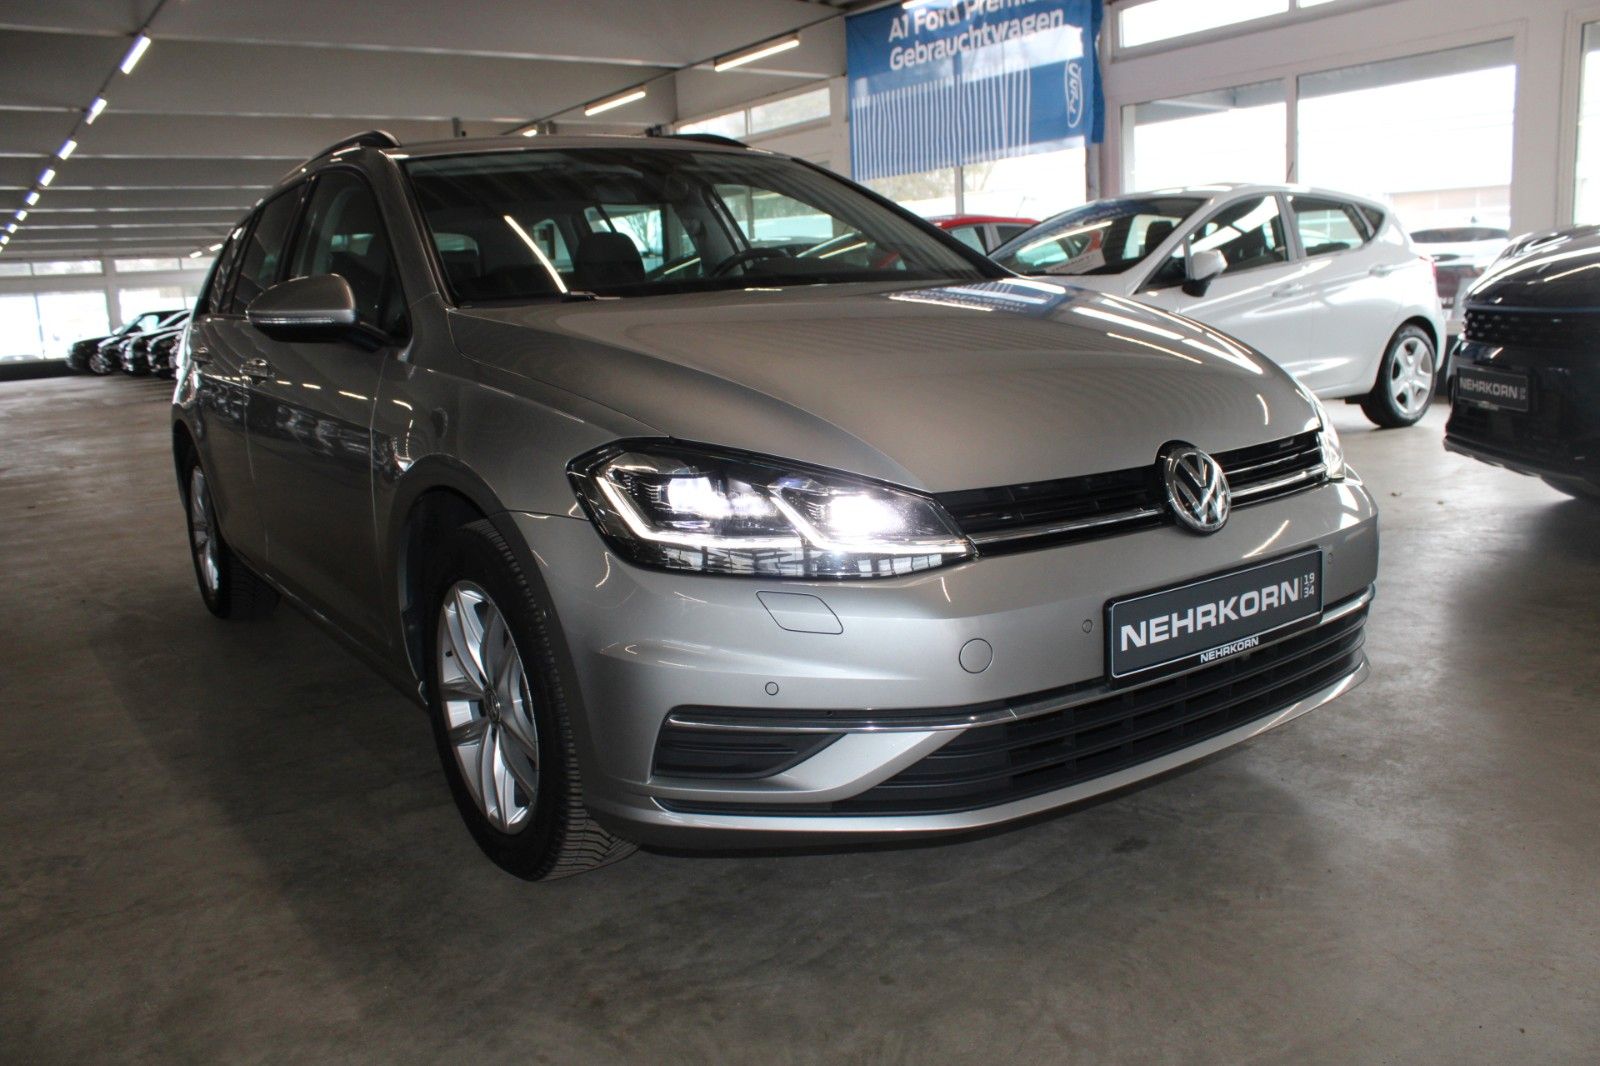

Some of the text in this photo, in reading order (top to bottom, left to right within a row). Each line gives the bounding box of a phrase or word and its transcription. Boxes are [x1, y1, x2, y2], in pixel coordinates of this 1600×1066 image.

[914, 0, 960, 35] Ford
[889, 8, 1064, 71] Gebrauchtwagen
[1459, 377, 1518, 399] NEHRKORN
[1303, 585, 1315, 598] 34
[1121, 572, 1315, 652] NEHRKORN 19
[1200, 637, 1259, 664] NEHRKORN
